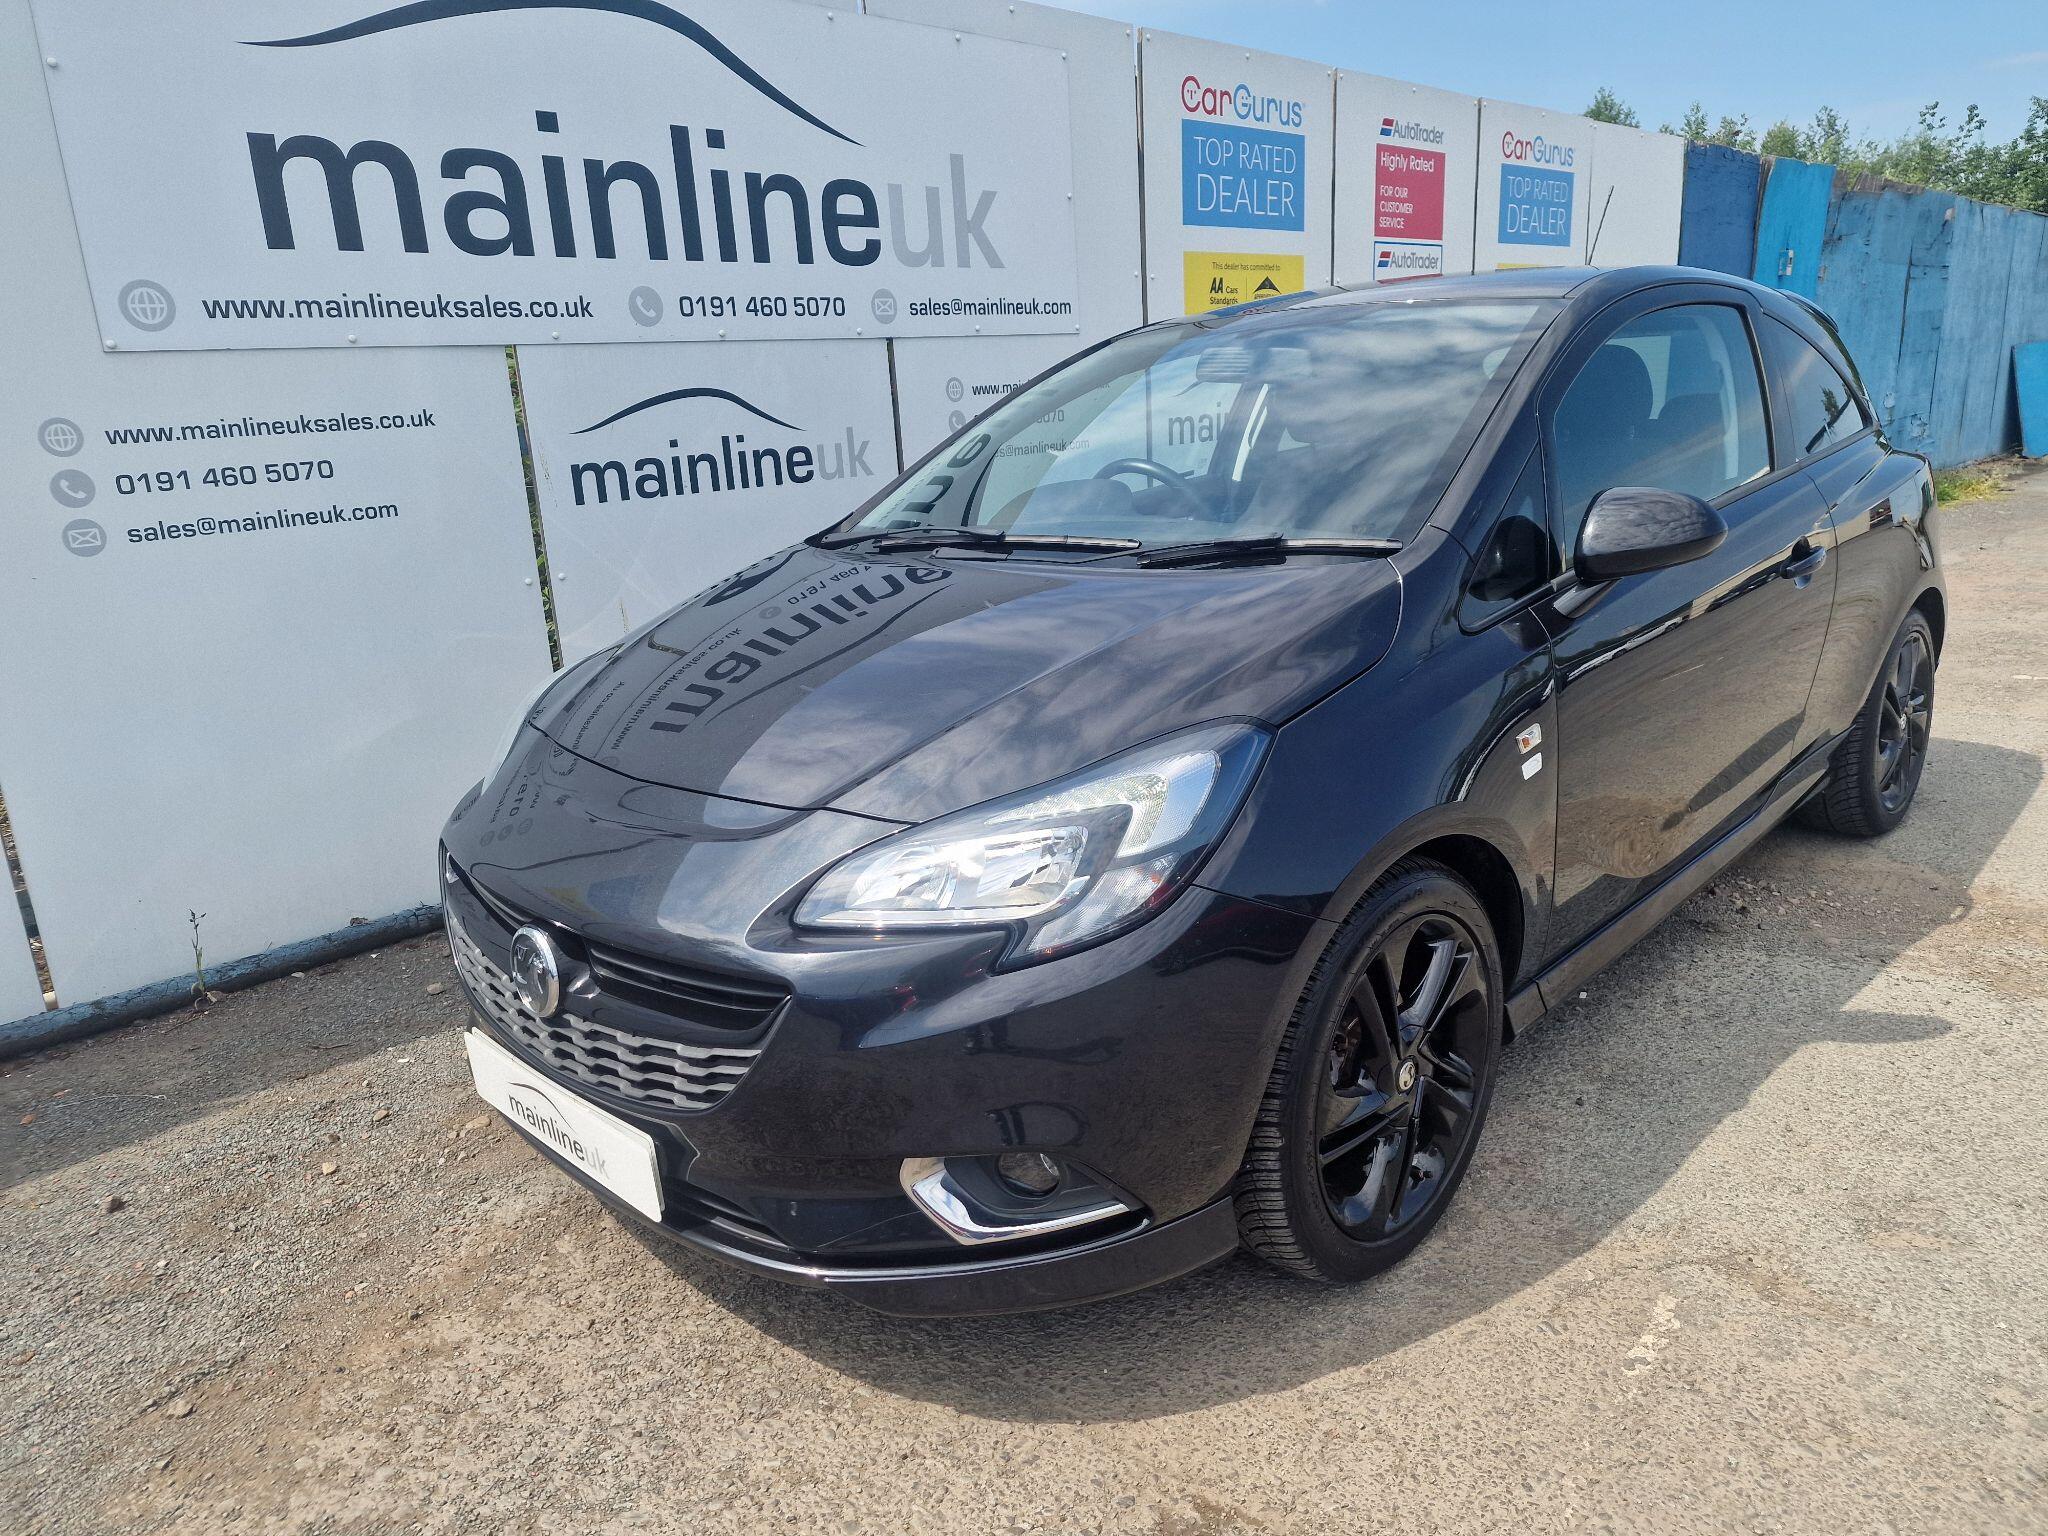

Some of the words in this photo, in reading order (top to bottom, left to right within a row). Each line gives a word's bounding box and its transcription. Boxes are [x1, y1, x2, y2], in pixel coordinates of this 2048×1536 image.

[1181, 75, 1302, 127] CarGurus
[1393, 119, 1444, 145] AutoTrader
[1194, 136, 1233, 167] TOP
[1239, 142, 1296, 174] RATED
[1380, 151, 1407, 172] Highly
[1409, 155, 1434, 173] Rated
[1501, 131, 1574, 168] CarGurus
[246, 110, 1005, 269] mainlineuk
[1197, 173, 1295, 217] DEALER
[1380, 185, 1394, 197] FOR
[1394, 186, 1408, 199] OUR
[1507, 175, 1531, 199] TOP
[1534, 178, 1568, 203] RATED
[1379, 200, 1414, 214] CUSTOMER
[1506, 203, 1566, 236] DEALER
[1379, 216, 1405, 229] SERVICE
[1212, 261, 1223, 270] This
[1223, 263, 1240, 271] dealer
[1240, 263, 1249, 271] has
[1249, 263, 1275, 271] committed
[1390, 252, 1439, 270] AutoTrader
[1209, 276, 1224, 294] AA
[1225, 285, 1239, 294] Cars
[201, 292, 594, 319] www.mainlineuksales.co.uk
[679, 295, 737, 317] 0191
[745, 296, 787, 317] 460
[793, 296, 846, 317] 5070
[909, 297, 1072, 317] sales@mainlineuk.com
[104, 408, 436, 445] www.mainlineuksales.co.uk
[115, 470, 191, 495] 0191
[202, 465, 257, 488] 460
[264, 459, 334, 483] 5070
[570, 427, 874, 506] mainlineuk
[127, 504, 399, 543] sales@mainlineuk.com
[508, 1094, 609, 1179] mainlineuk
